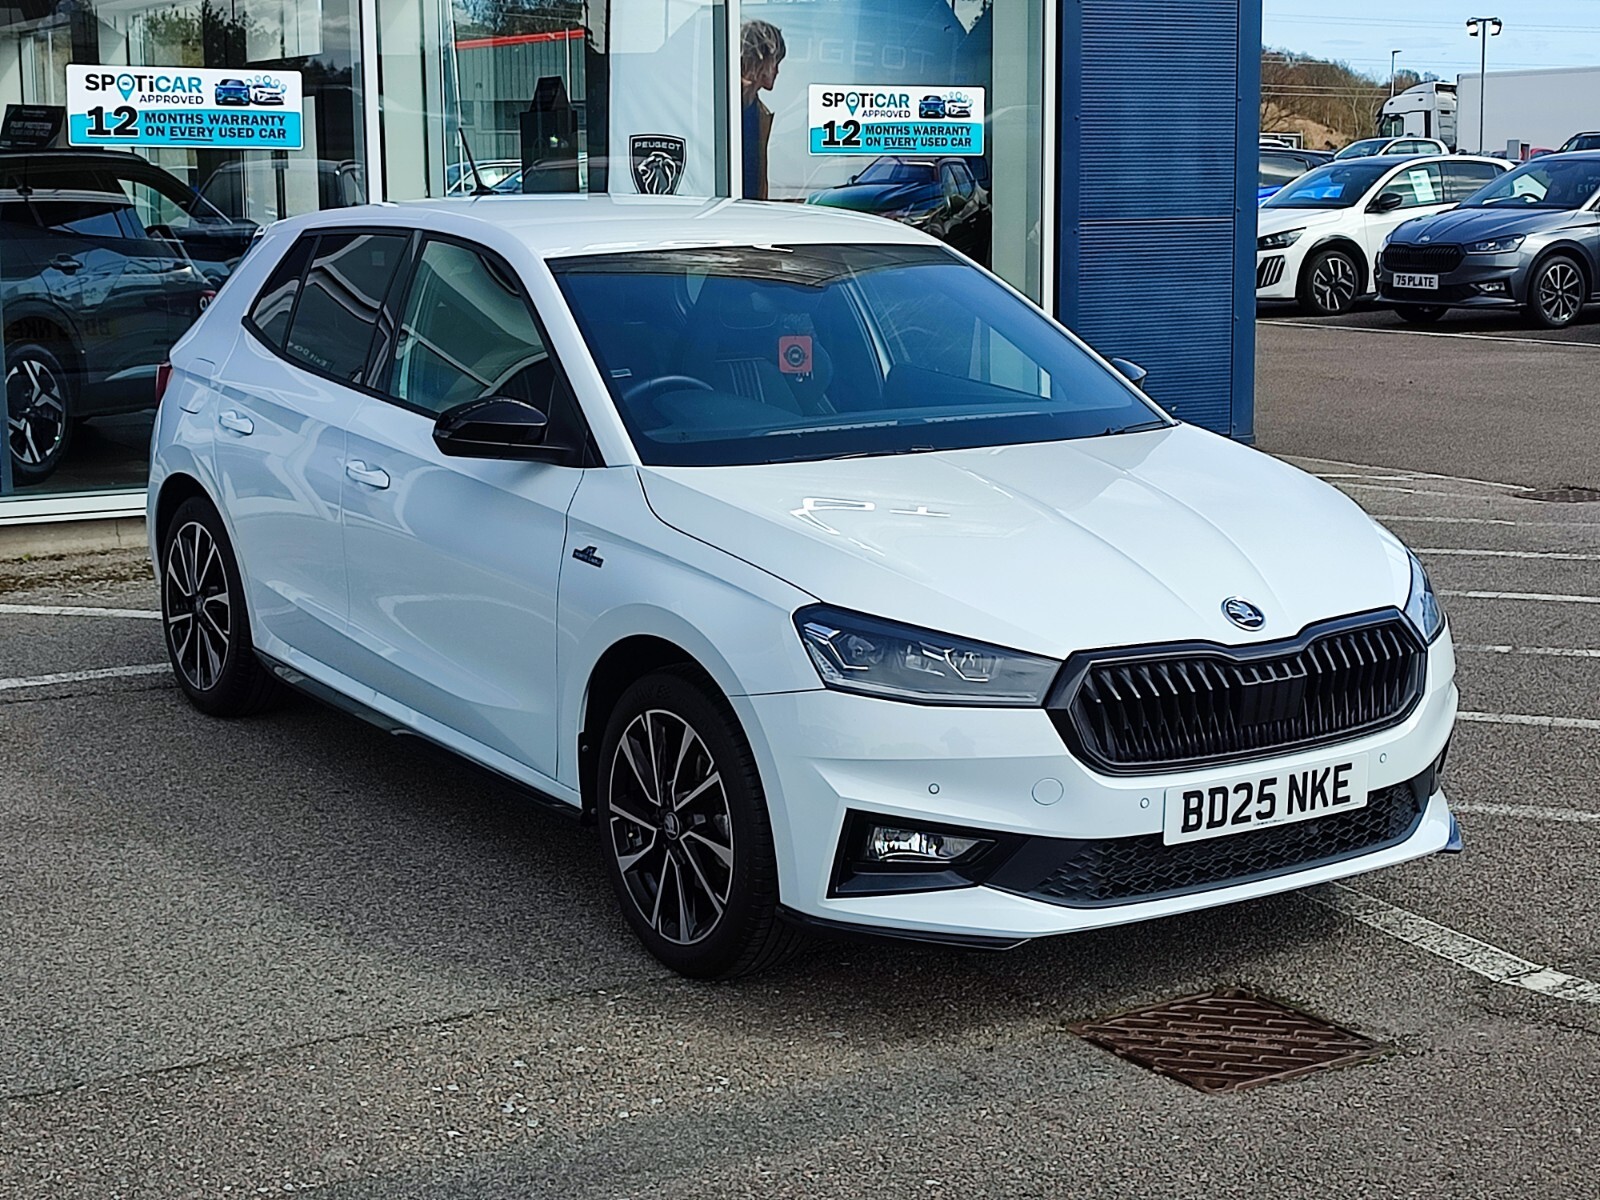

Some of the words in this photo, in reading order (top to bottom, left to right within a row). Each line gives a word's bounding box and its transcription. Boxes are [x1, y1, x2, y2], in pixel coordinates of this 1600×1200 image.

[85, 73, 203, 101] SPOTiCAR
[139, 94, 204, 105] APPROVED
[822, 92, 910, 115] SPOTiCAR
[144, 113, 204, 125] MONTHS
[208, 114, 286, 126] WARRANTY
[861, 110, 911, 118] APPROVED
[87, 106, 139, 136] 12
[145, 126, 165, 136] ON
[170, 126, 215, 137] EVERY
[219, 127, 255, 138] USED
[259, 128, 287, 139] CAR
[822, 119, 861, 146] 12
[865, 125, 910, 135] MONTHS
[913, 126, 972, 136] WARRANTY
[634, 141, 681, 151] PEUGEOT
[865, 137, 881, 146] ON
[884, 137, 918, 147] EVERY
[920, 137, 948, 147] USED
[950, 137, 972, 147] CAR
[1395, 274, 1407, 286] 75
[1407, 275, 1435, 287] PLATE
[1181, 777, 1278, 834] BD25
[1287, 762, 1353, 815] NKE
